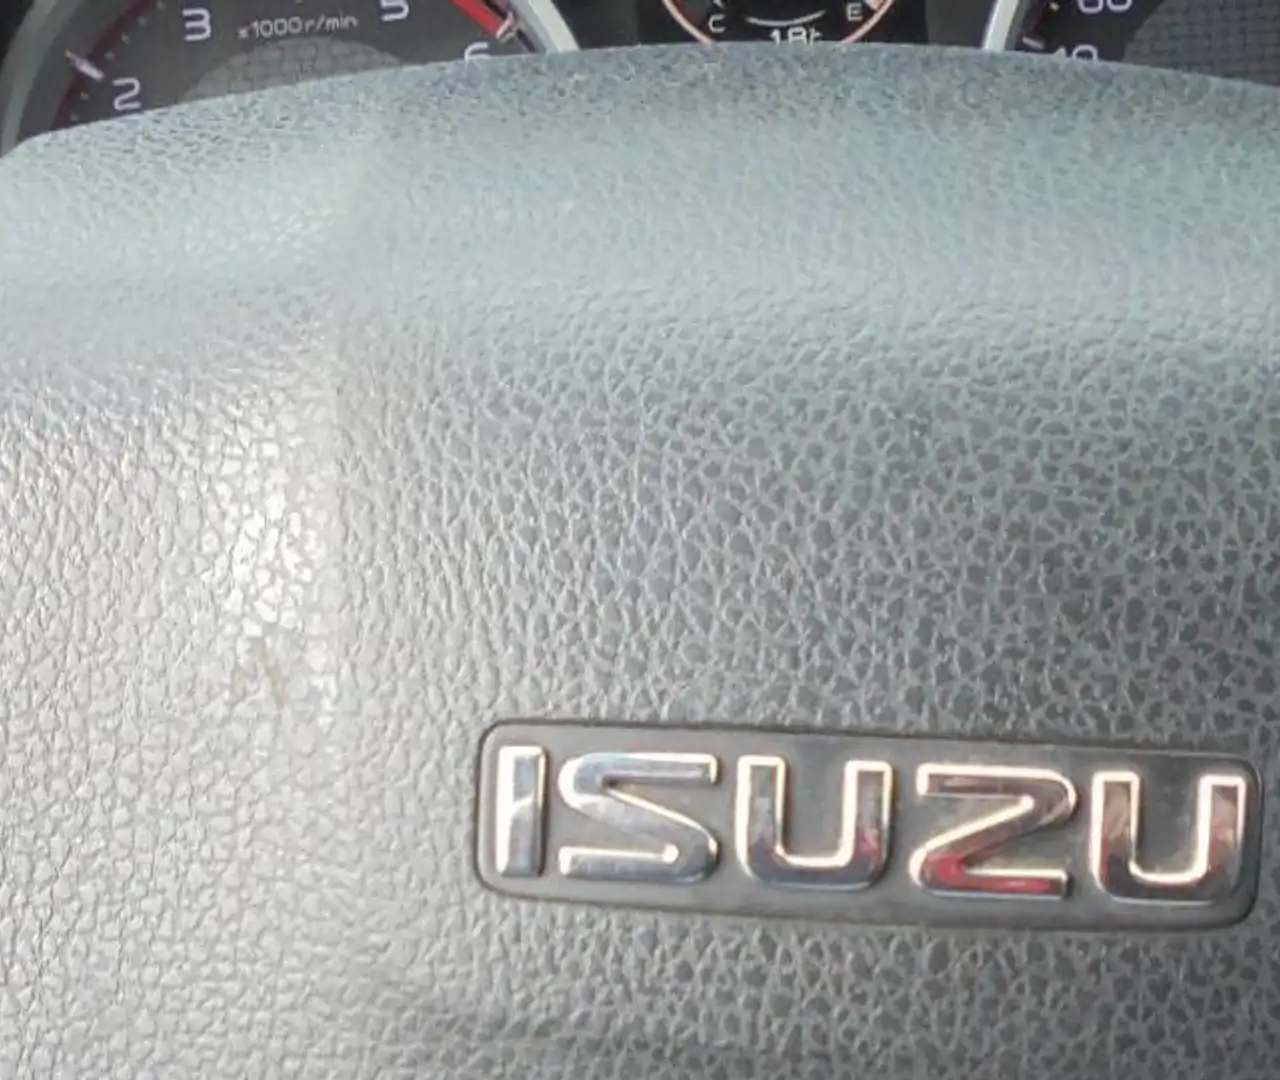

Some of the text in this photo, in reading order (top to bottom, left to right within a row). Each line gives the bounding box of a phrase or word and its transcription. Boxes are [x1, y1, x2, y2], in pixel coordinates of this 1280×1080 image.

[181, 7, 212, 41] 3
[708, 14, 726, 33] C
[846, 2, 863, 21] E
[112, 77, 142, 111] 2
[495, 744, 1247, 903] ISUZU
